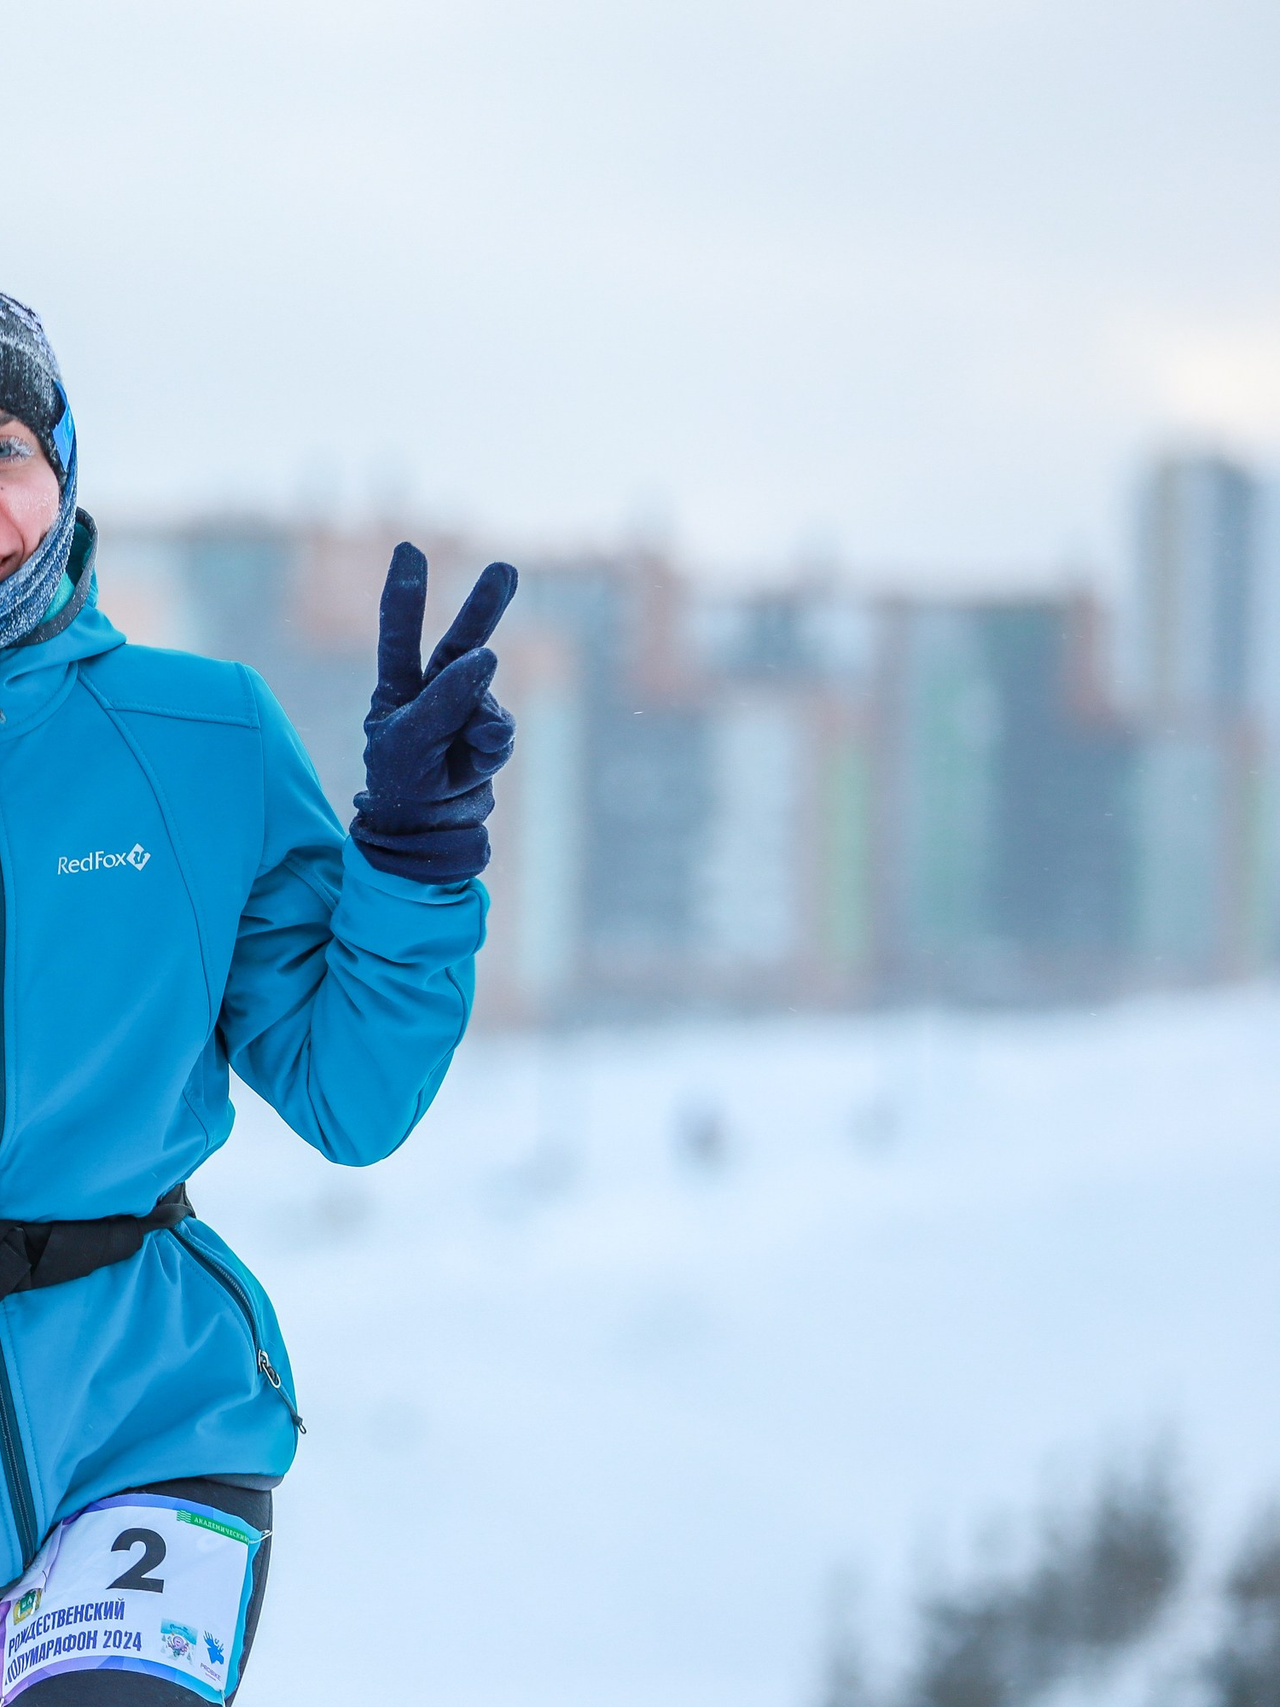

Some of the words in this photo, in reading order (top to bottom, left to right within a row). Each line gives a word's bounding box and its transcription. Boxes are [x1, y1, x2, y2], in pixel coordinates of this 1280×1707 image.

[106, 1527, 167, 1594] 2
[8, 1597, 125, 1658] РОЖДЕСТВЕНСКИЙ
[102, 1629, 142, 1652] 2024
